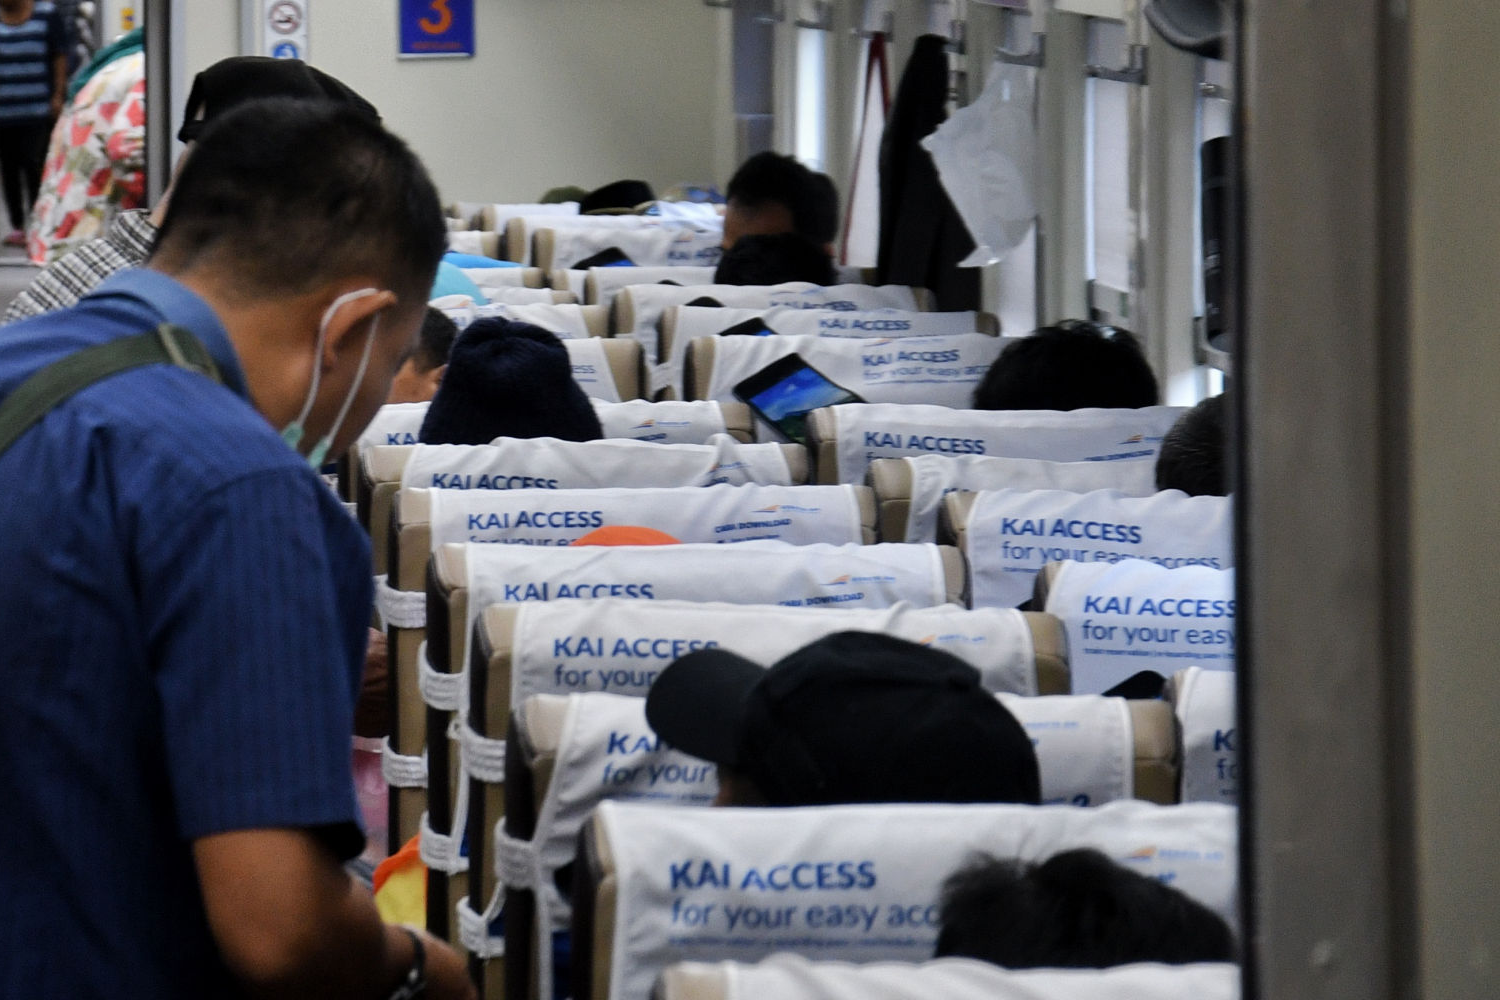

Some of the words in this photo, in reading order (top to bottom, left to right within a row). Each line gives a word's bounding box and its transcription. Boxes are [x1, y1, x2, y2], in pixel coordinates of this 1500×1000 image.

[819, 319, 847, 330] KAI
[852, 319, 912, 331] ACCESS
[861, 353, 893, 366] KAI
[898, 349, 961, 362] ACCESS
[864, 431, 902, 448] KAI
[907, 435, 986, 455] ACCESS
[432, 472, 471, 490] KAI
[477, 474, 559, 490] ACCESS
[468, 512, 510, 530] KAI
[514, 509, 604, 529] ACCESS
[1002, 518, 1045, 536] KAI
[1050, 518, 1142, 544] ACCESS
[1002, 541, 1037, 560] for
[1039, 547, 1088, 565] your
[505, 582, 548, 601] KAI
[556, 582, 655, 600] ACCESS
[1084, 595, 1132, 615] KAI
[1138, 597, 1235, 619] ACCESS
[1082, 619, 1117, 641] for
[1123, 625, 1179, 646] your
[553, 636, 604, 659] KAI
[554, 664, 595, 688] for
[597, 668, 658, 690] your
[602, 761, 639, 786] for
[649, 762, 712, 786] your
[669, 859, 731, 891] KAI
[740, 860, 877, 892] ACCESS
[671, 897, 715, 925] for
[723, 903, 797, 932] your
[805, 904, 879, 933] easy
